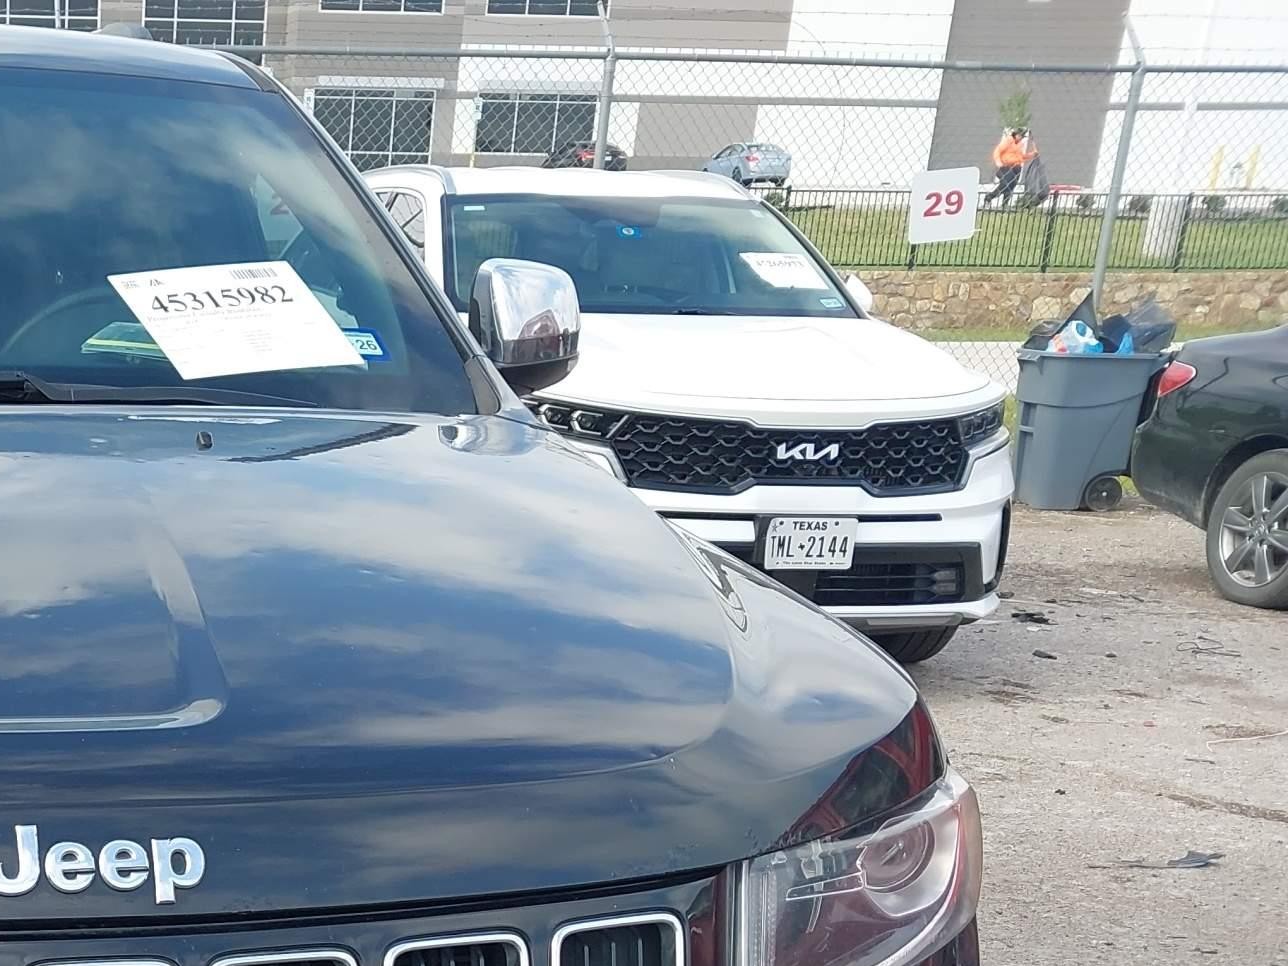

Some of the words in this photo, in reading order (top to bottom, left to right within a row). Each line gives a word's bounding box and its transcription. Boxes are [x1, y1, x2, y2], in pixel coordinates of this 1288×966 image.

[922, 190, 965, 218] 29
[150, 284, 295, 313] 45315982
[776, 442, 840, 461] KIA
[792, 520, 829, 532] TEXAS
